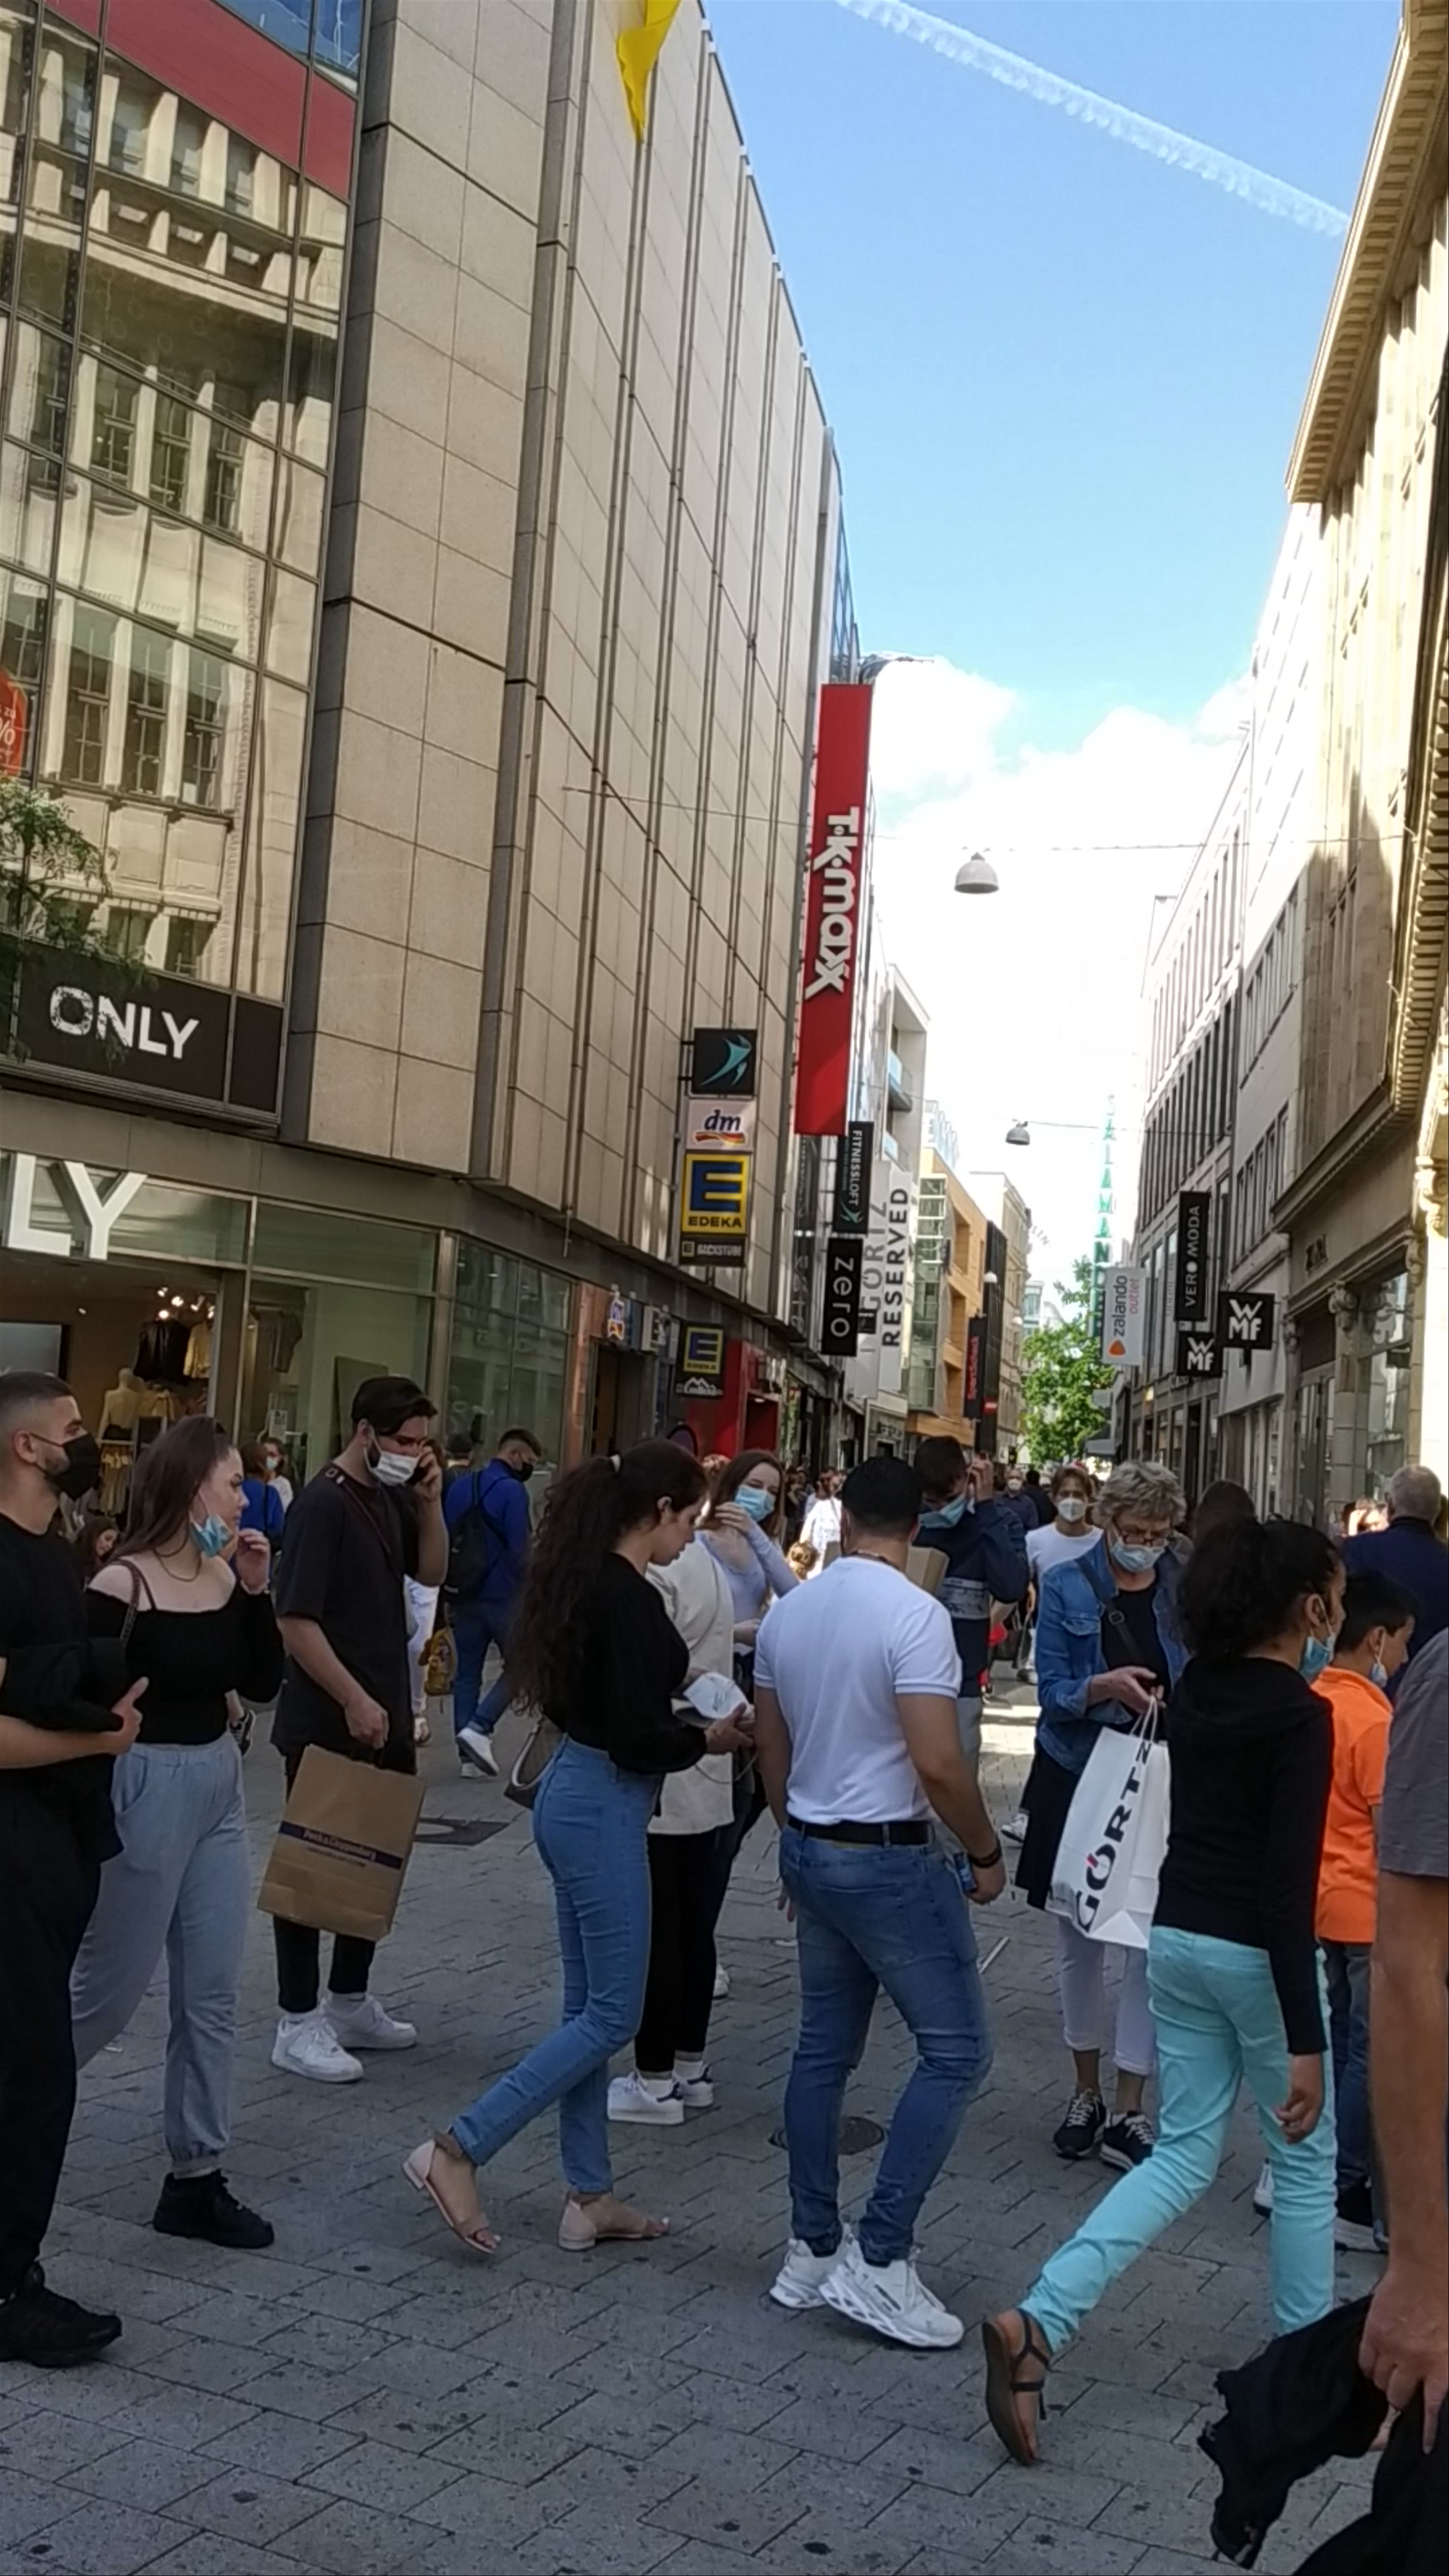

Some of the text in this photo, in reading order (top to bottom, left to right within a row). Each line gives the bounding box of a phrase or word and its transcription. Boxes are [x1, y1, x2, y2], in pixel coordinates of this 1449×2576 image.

[49, 986, 199, 1058] ONLY
[704, 1109, 741, 1132] dm
[849, 1130, 863, 1206] FITNESSLOFT
[688, 1216, 742, 1228] EDEKA
[1187, 1205, 1200, 1258] MODA
[881, 1189, 908, 1346] RESERVED
[1111, 1275, 1127, 1337] zalando
[1129, 1278, 1139, 1315] outlet
